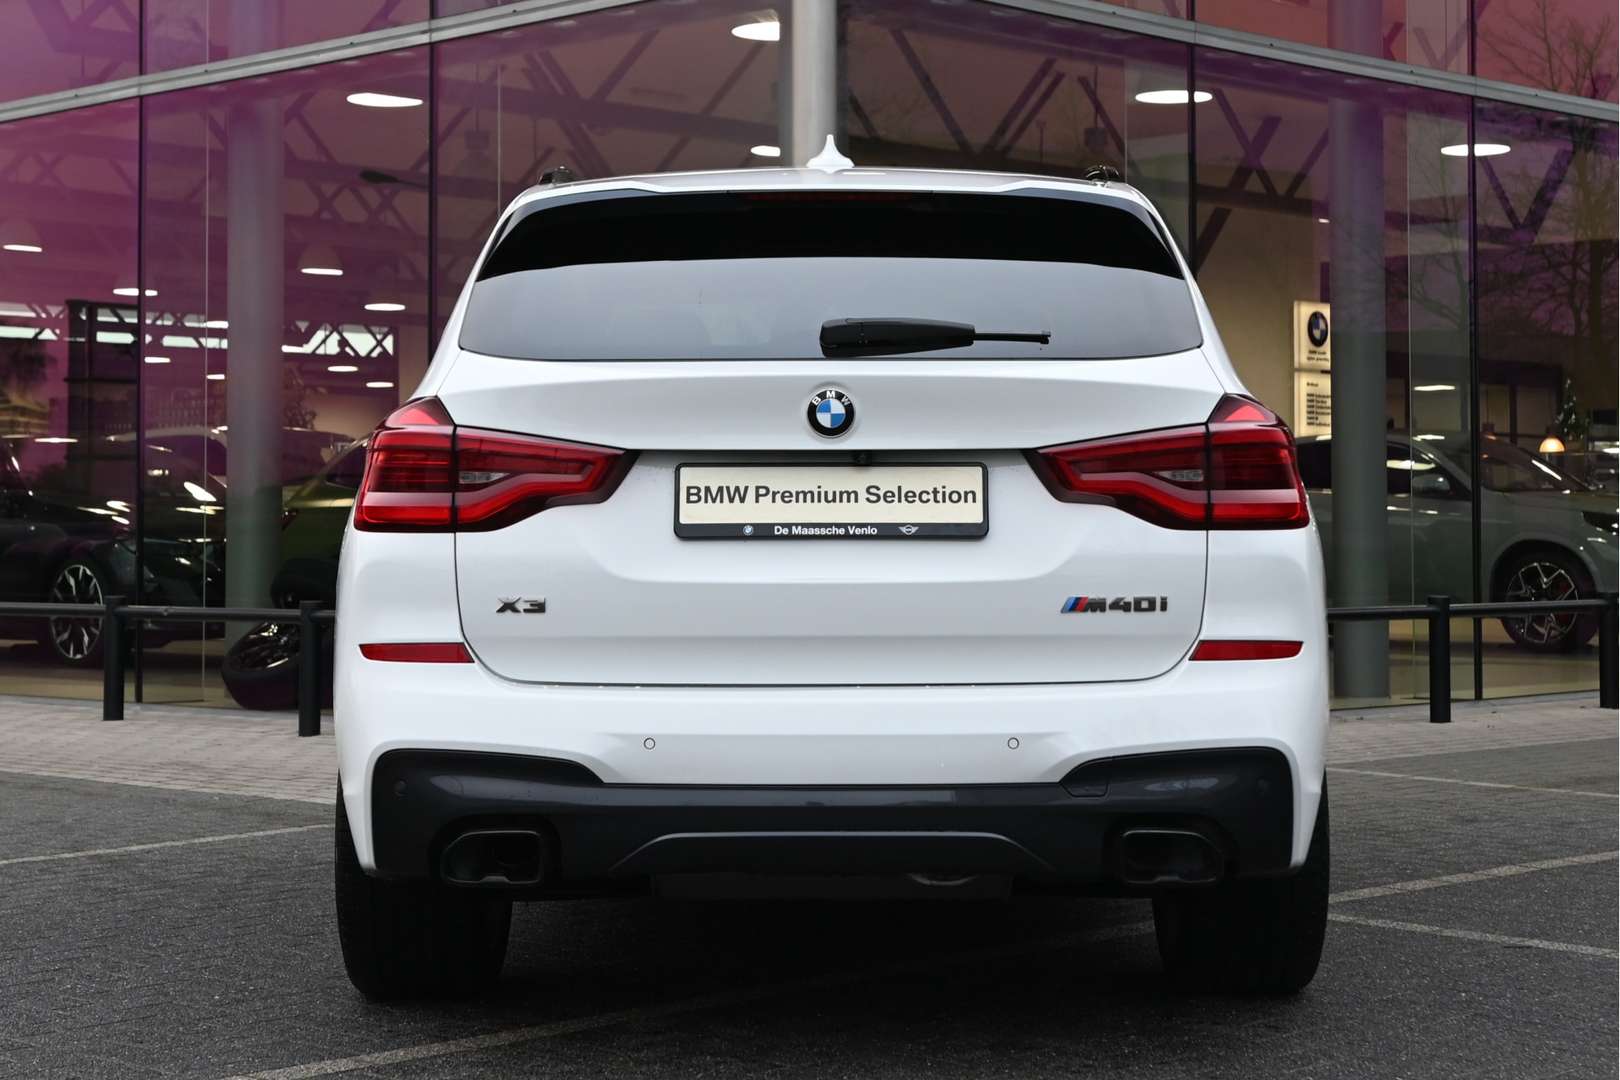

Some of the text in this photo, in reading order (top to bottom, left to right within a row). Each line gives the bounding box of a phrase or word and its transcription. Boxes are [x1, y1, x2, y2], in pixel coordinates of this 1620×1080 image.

[811, 390, 851, 406] BMW
[685, 484, 977, 504] BMW Premium Selection
[774, 525, 878, 535] De Maassche Venlo
[495, 597, 546, 614] X3
[1063, 596, 1168, 613] M40i
